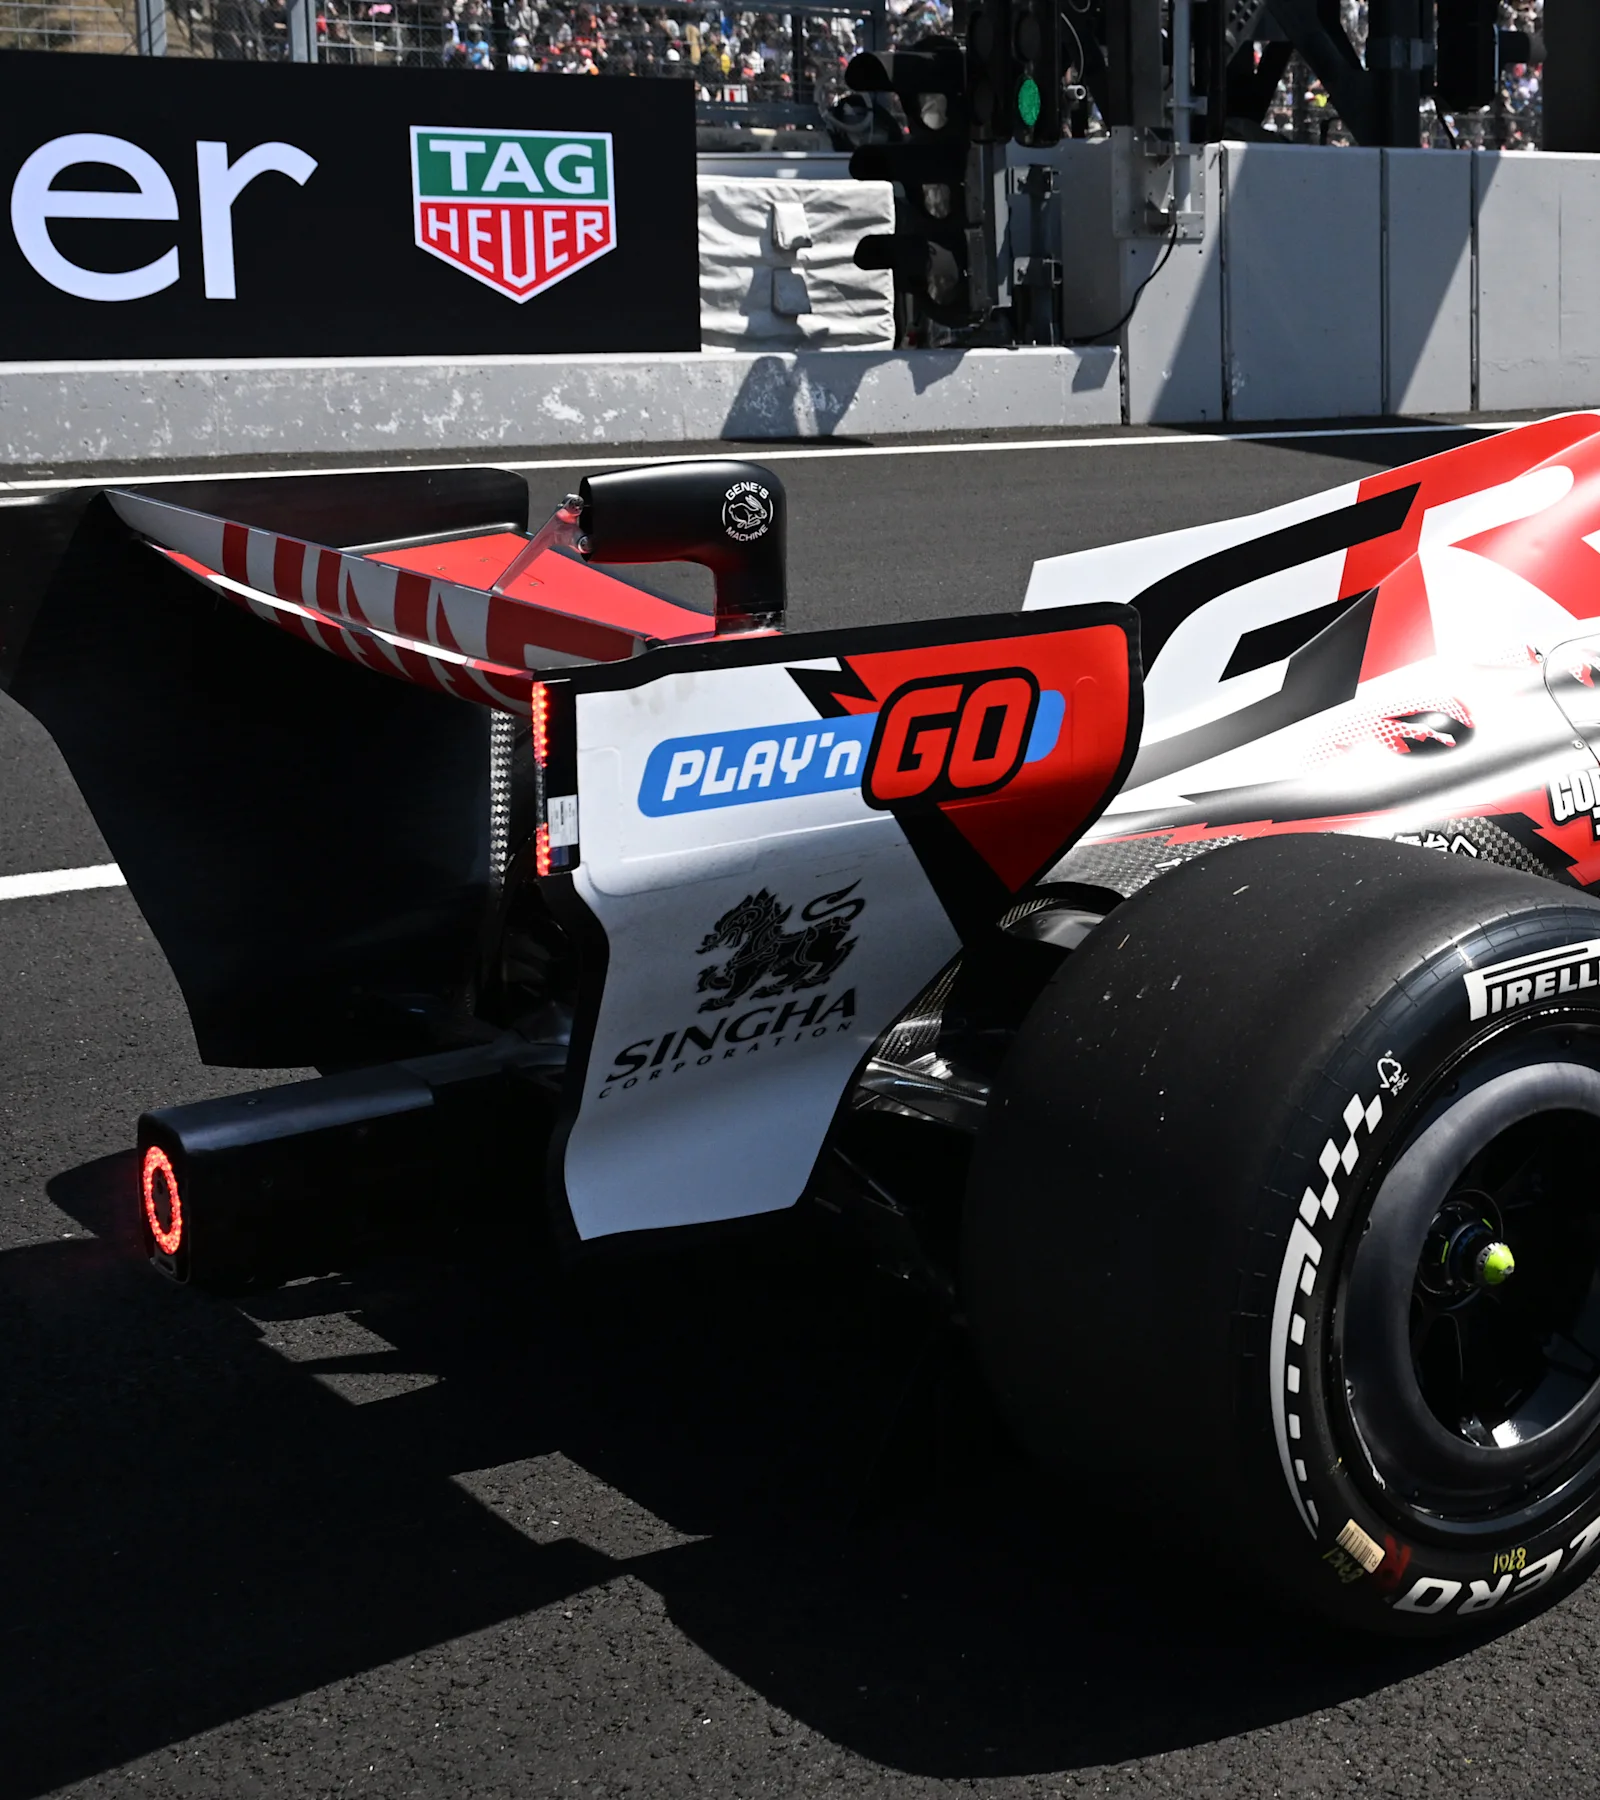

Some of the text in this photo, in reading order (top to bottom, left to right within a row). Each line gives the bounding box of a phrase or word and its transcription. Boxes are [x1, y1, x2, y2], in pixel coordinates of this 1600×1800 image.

[428, 138, 596, 196] TAG
[426, 206, 607, 289] HEUER
[725, 481, 769, 501] GENE'S
[725, 524, 768, 542] MACHINE
[662, 675, 1030, 802] PLAY'n GO
[598, 1020, 853, 1100] CORPORATION
[604, 985, 857, 1084] SINGHA
[1390, 1072, 1410, 1097] FSC
[1366, 1552, 1379, 1568] R1
